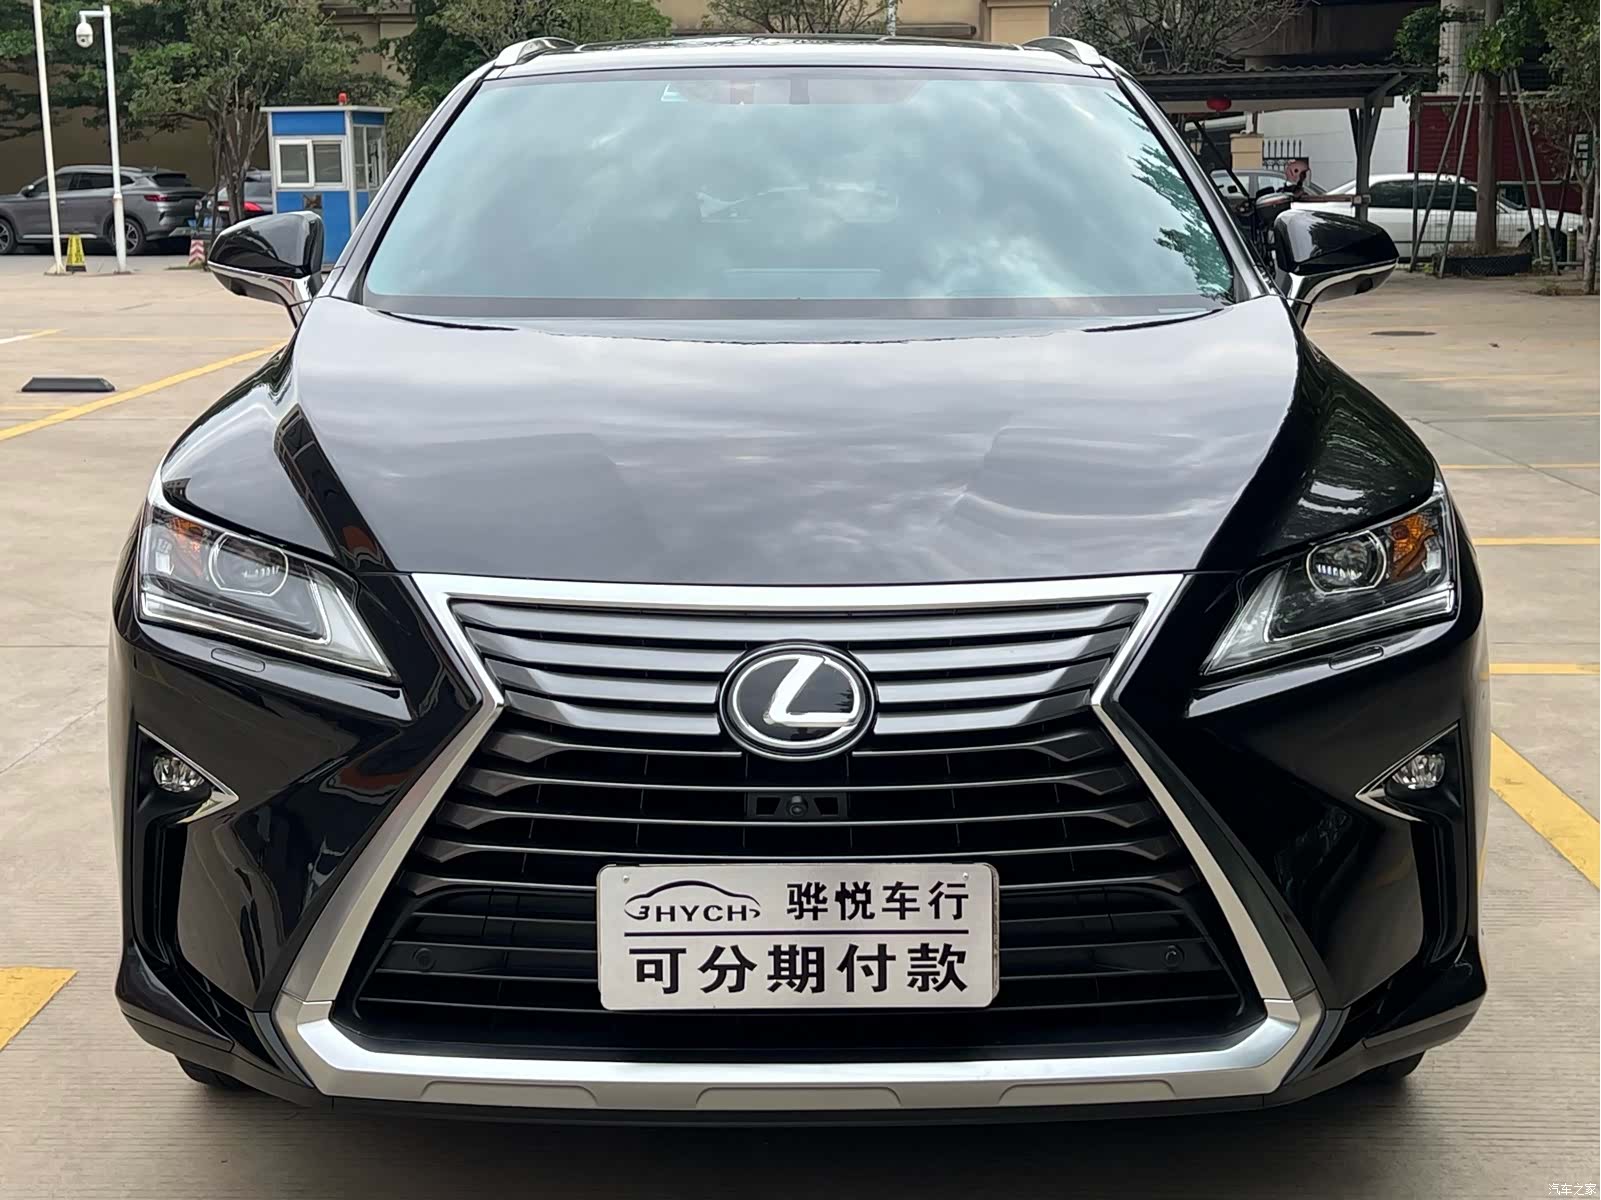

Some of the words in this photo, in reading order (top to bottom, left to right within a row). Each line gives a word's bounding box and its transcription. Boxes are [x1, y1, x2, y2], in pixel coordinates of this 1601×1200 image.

[787, 881, 969, 921] 骅悦车行
[629, 943, 968, 994] 可分期付款
